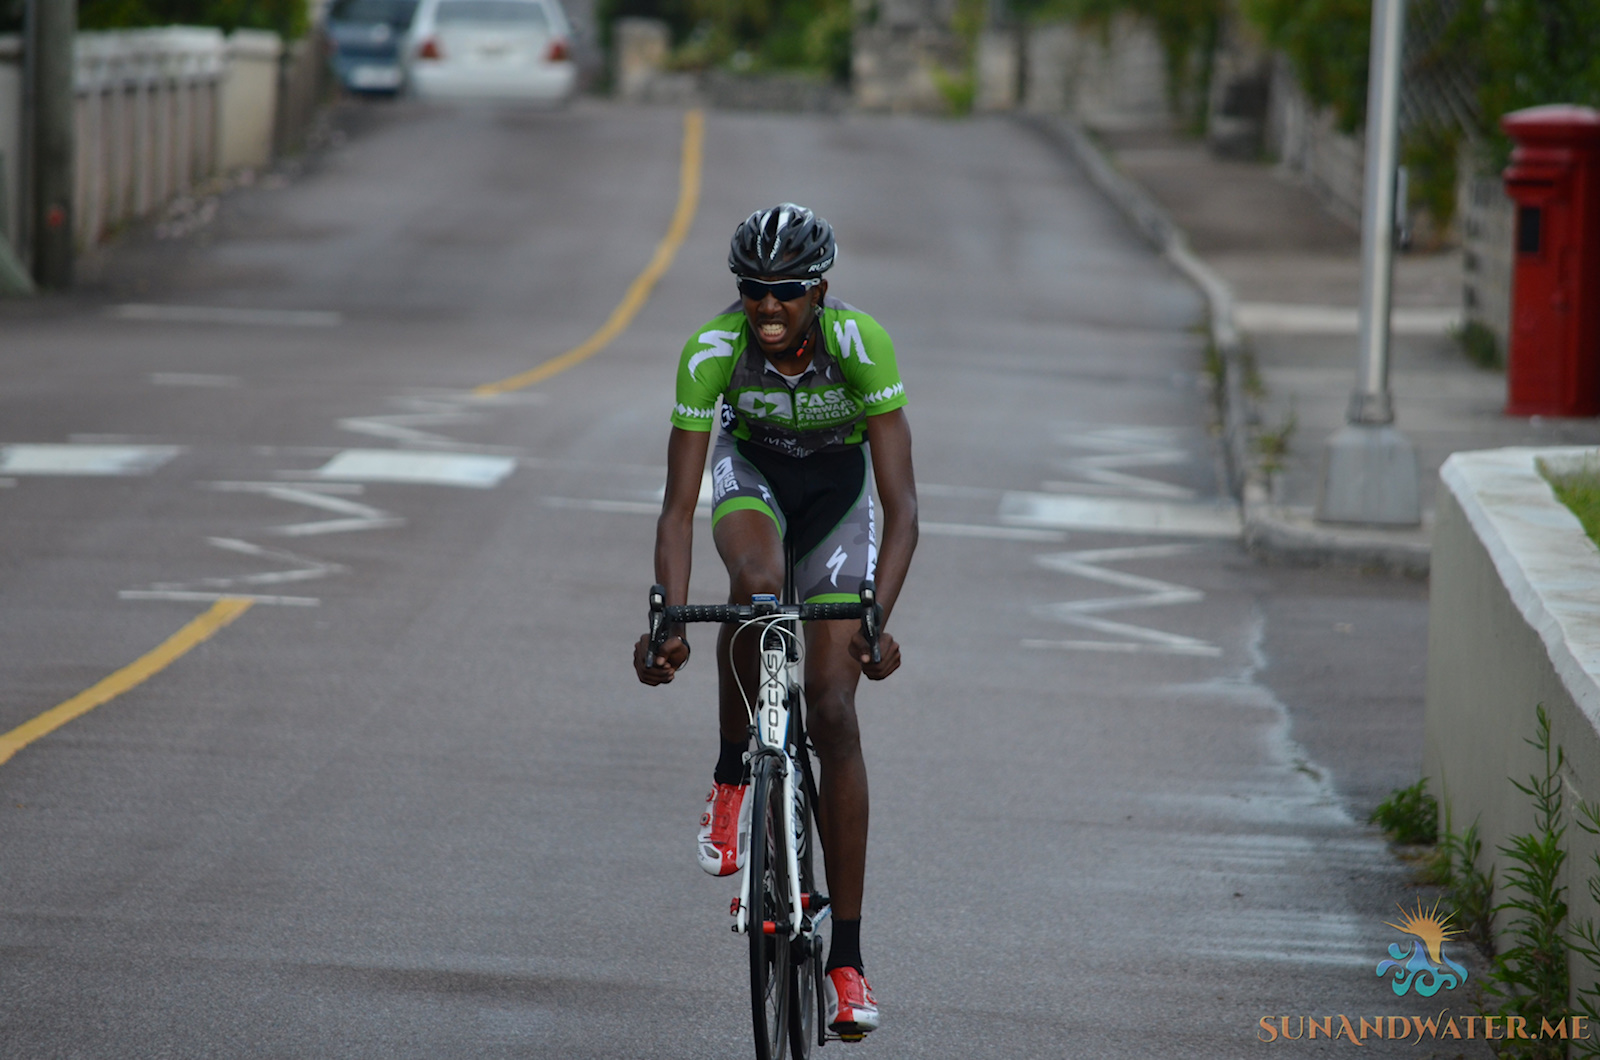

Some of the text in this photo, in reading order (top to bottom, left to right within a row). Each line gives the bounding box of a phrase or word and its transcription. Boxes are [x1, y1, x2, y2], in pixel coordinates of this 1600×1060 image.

[796, 387, 846, 407] FAST
[796, 399, 854, 414] FORWARD
[797, 405, 857, 421] FREIGHT
[767, 653, 779, 745] FOCUS
